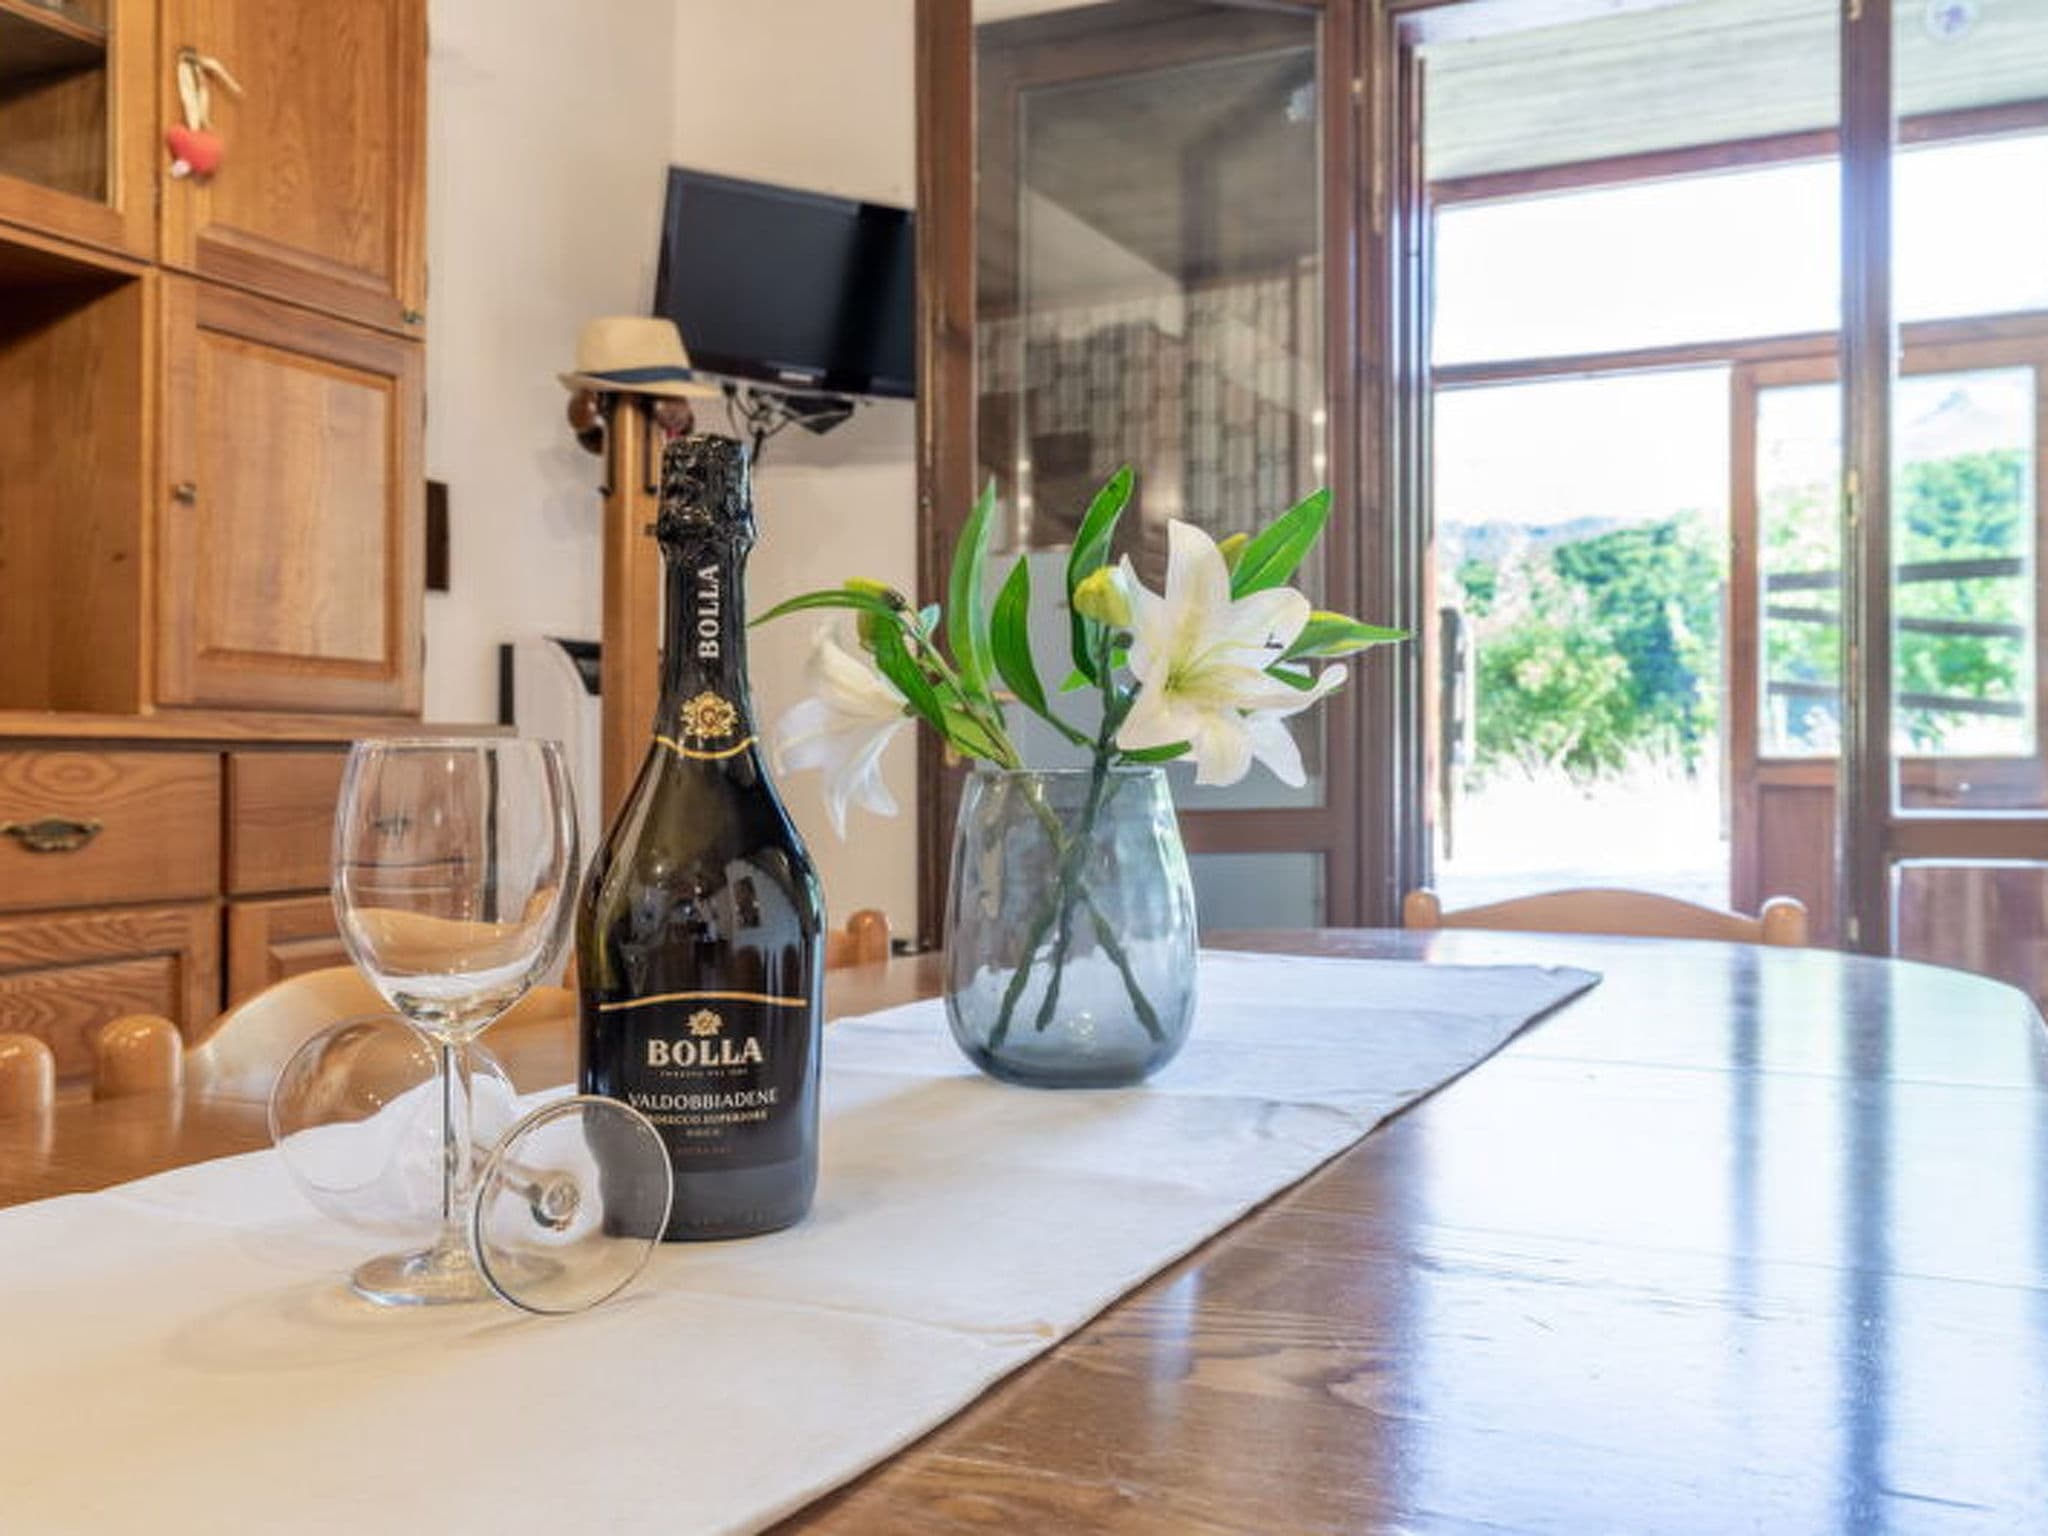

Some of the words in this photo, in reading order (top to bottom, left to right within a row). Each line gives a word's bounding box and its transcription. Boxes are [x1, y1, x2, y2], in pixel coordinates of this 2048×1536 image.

[698, 565, 720, 658] BOLLA
[647, 1037, 763, 1066] BOLLA
[628, 1088, 778, 1111] VALDOBBIADENE
